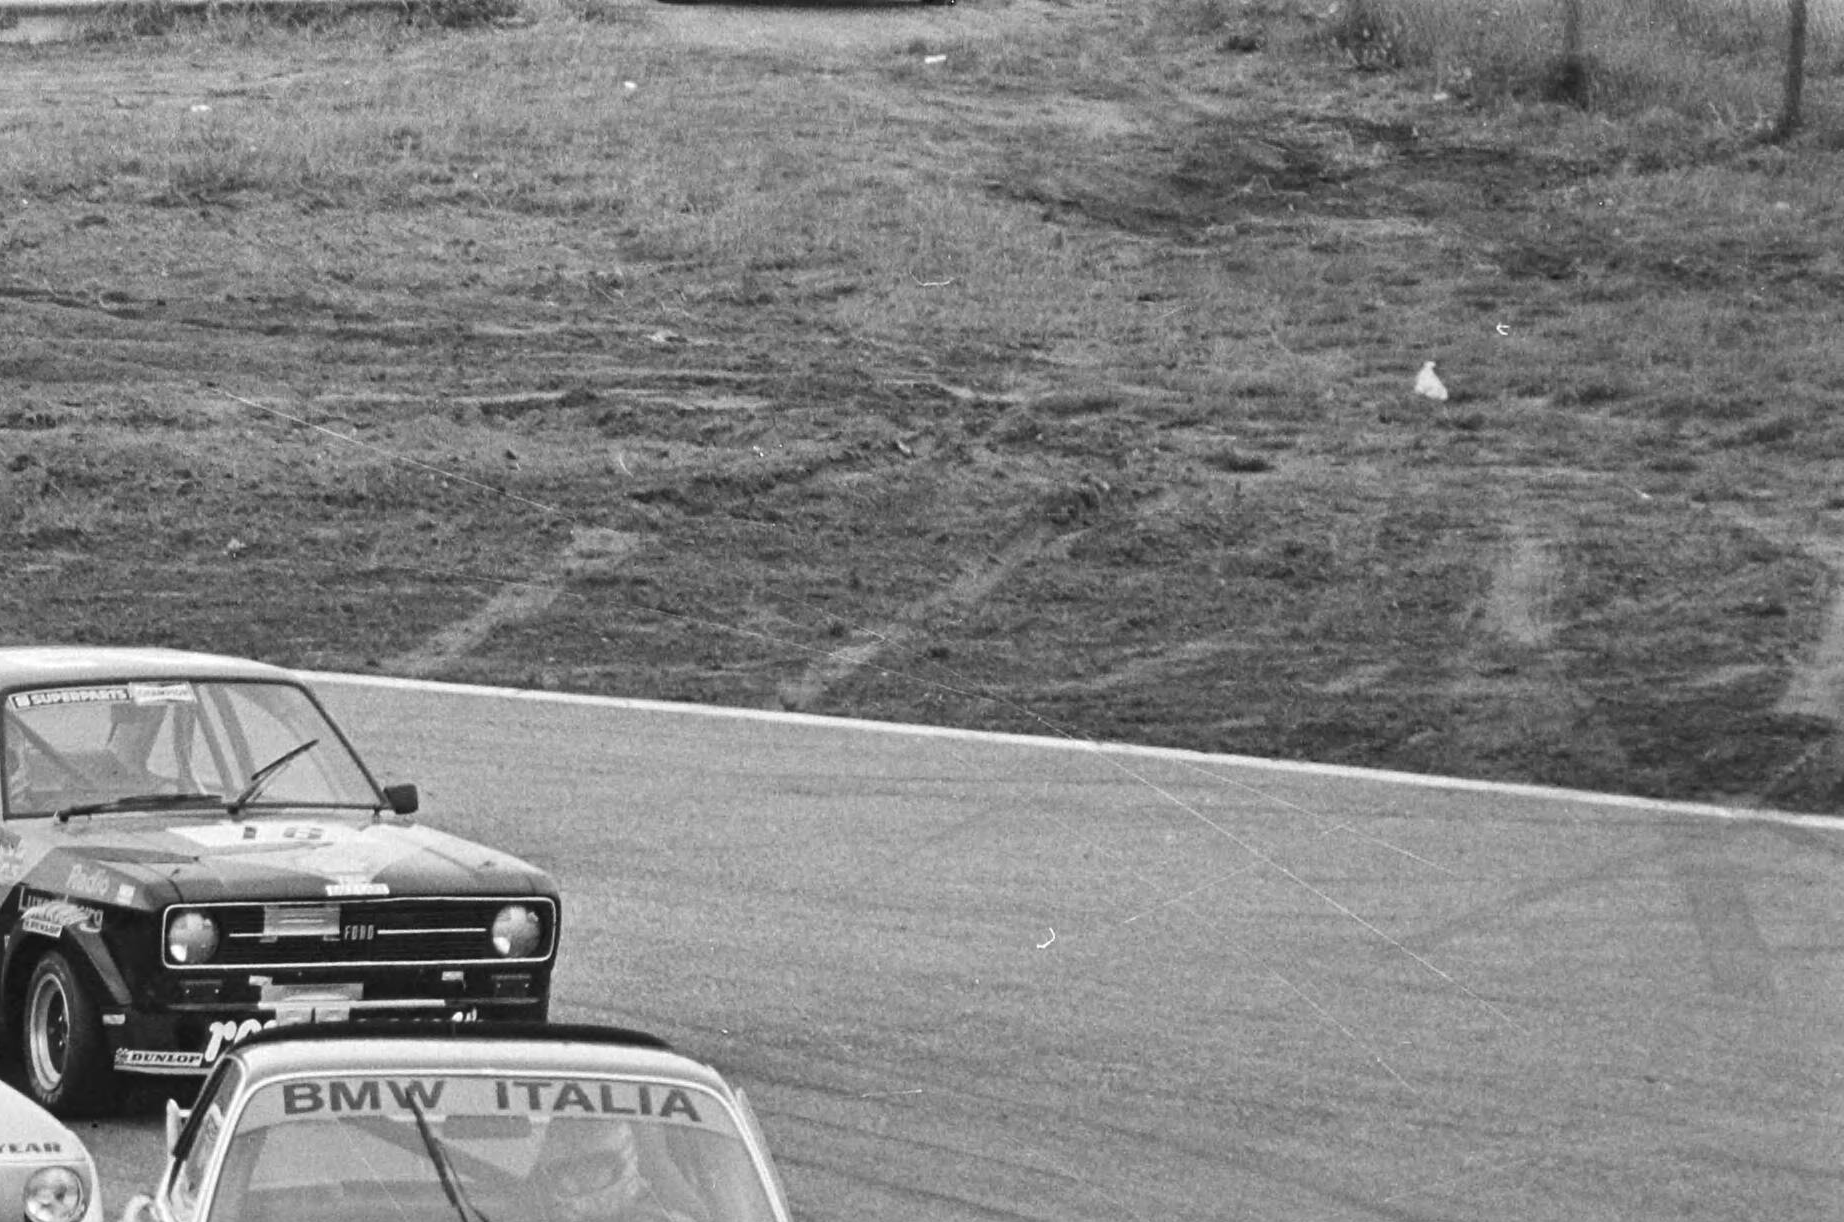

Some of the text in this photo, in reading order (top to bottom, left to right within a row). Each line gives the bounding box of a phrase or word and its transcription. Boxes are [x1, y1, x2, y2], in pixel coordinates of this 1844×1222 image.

[30, 690, 129, 706] SUPERPARTS
[344, 924, 376, 941] FORD
[130, 1052, 201, 1065] DUNLOP
[282, 1080, 703, 1123] BMW ITALIA
